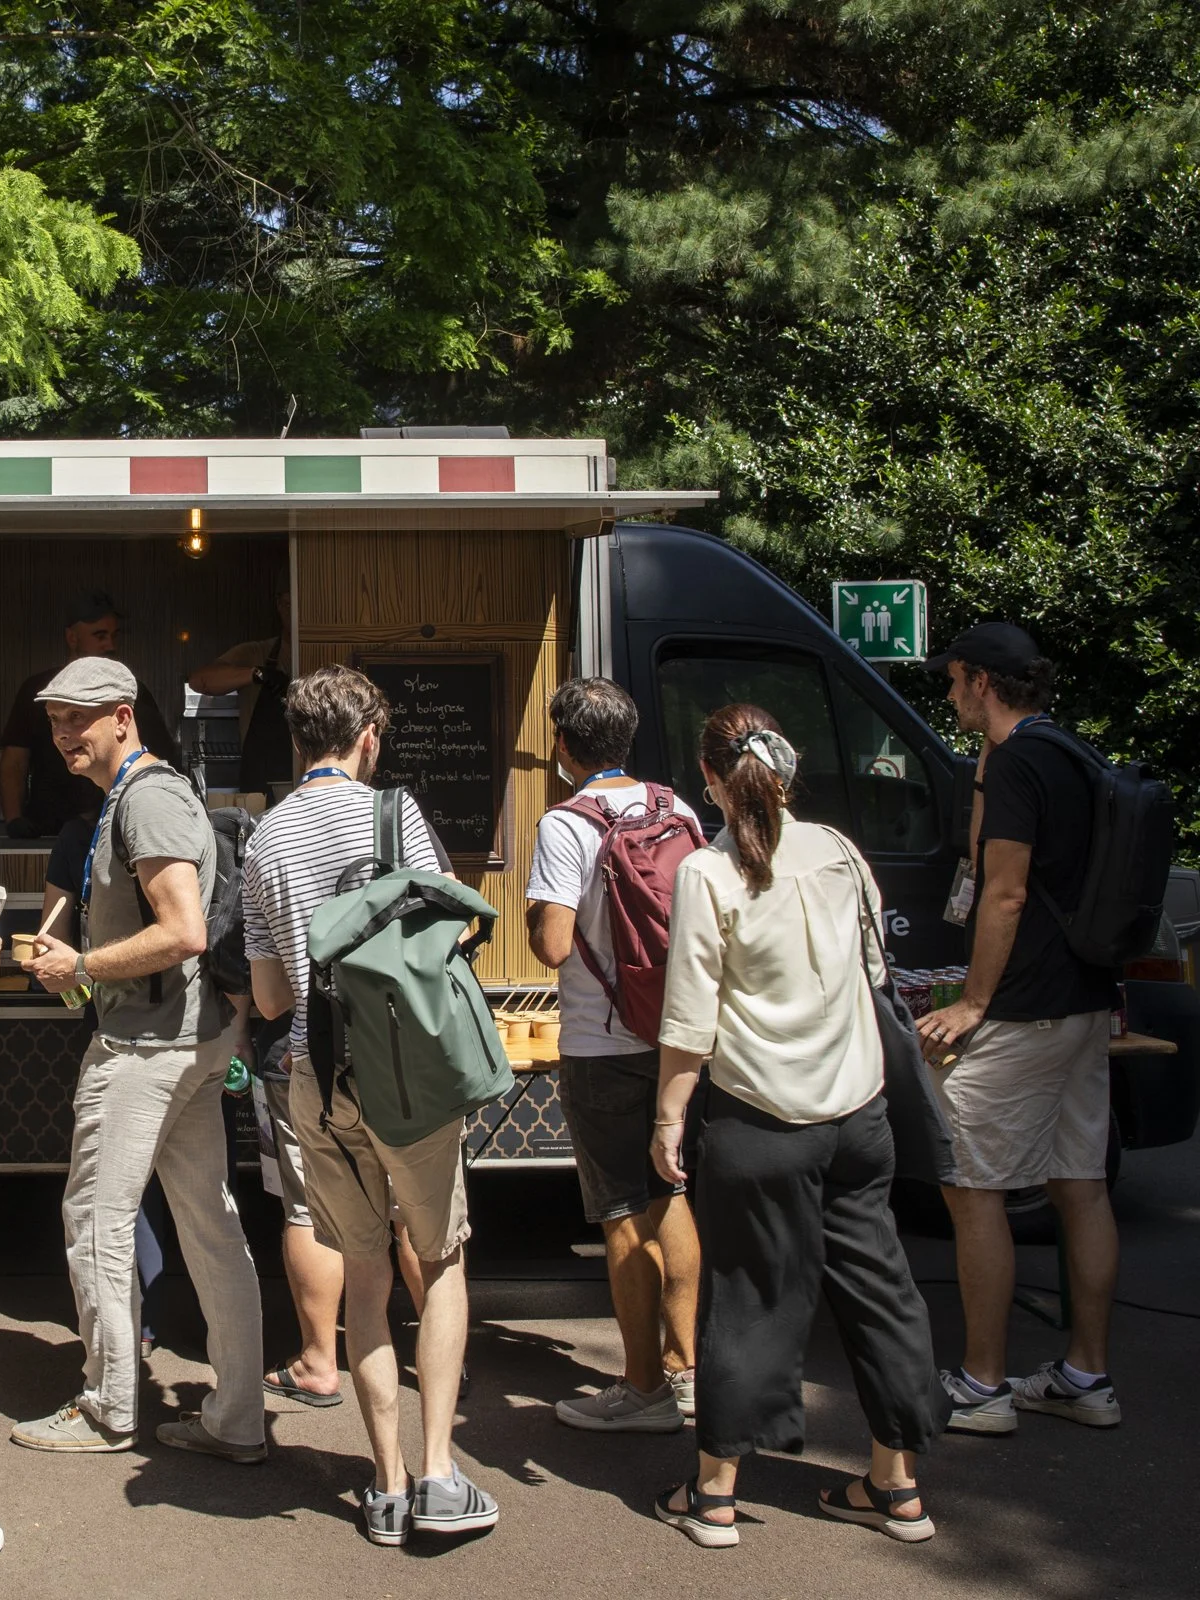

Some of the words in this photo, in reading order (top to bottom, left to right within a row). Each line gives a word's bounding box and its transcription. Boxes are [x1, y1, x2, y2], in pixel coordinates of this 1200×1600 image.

[403, 673, 439, 694] Menu
[390, 702, 408, 715] asta
[416, 701, 465, 720] bolognese
[401, 720, 438, 734] cheeses
[442, 720, 472, 740] pasta
[429, 770, 459, 781] smoked
[462, 770, 491, 781] salmon
[433, 810, 453, 826] Bon
